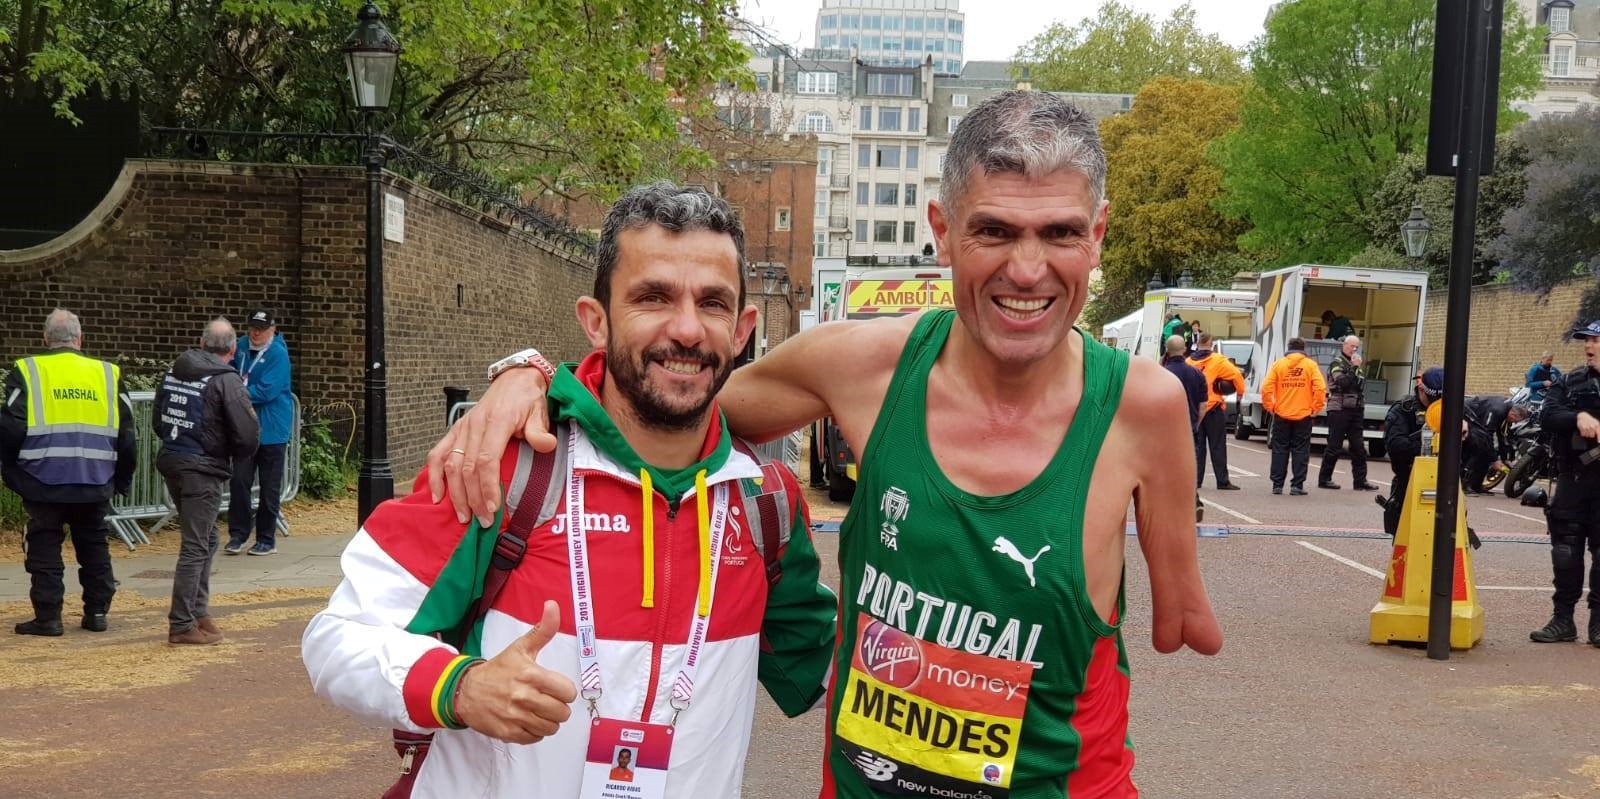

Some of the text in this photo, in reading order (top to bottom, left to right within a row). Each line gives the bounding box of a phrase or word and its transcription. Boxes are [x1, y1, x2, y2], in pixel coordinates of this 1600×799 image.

[53, 388, 98, 401] MARSHAL
[169, 393, 188, 406] 2019
[551, 512, 631, 535] Jma
[571, 505, 581, 537] LONDON
[714, 510, 724, 529] 2019
[573, 539, 584, 569] MONEY
[576, 571, 587, 600] VIRGIN
[579, 601, 589, 621] 2019
[856, 560, 1044, 670] PORTUGAL
[687, 622, 705, 667] MARATHON
[863, 624, 920, 681] Virgin
[927, 663, 1022, 701] money
[850, 678, 1012, 759] MENDES
[897, 778, 927, 793] new
